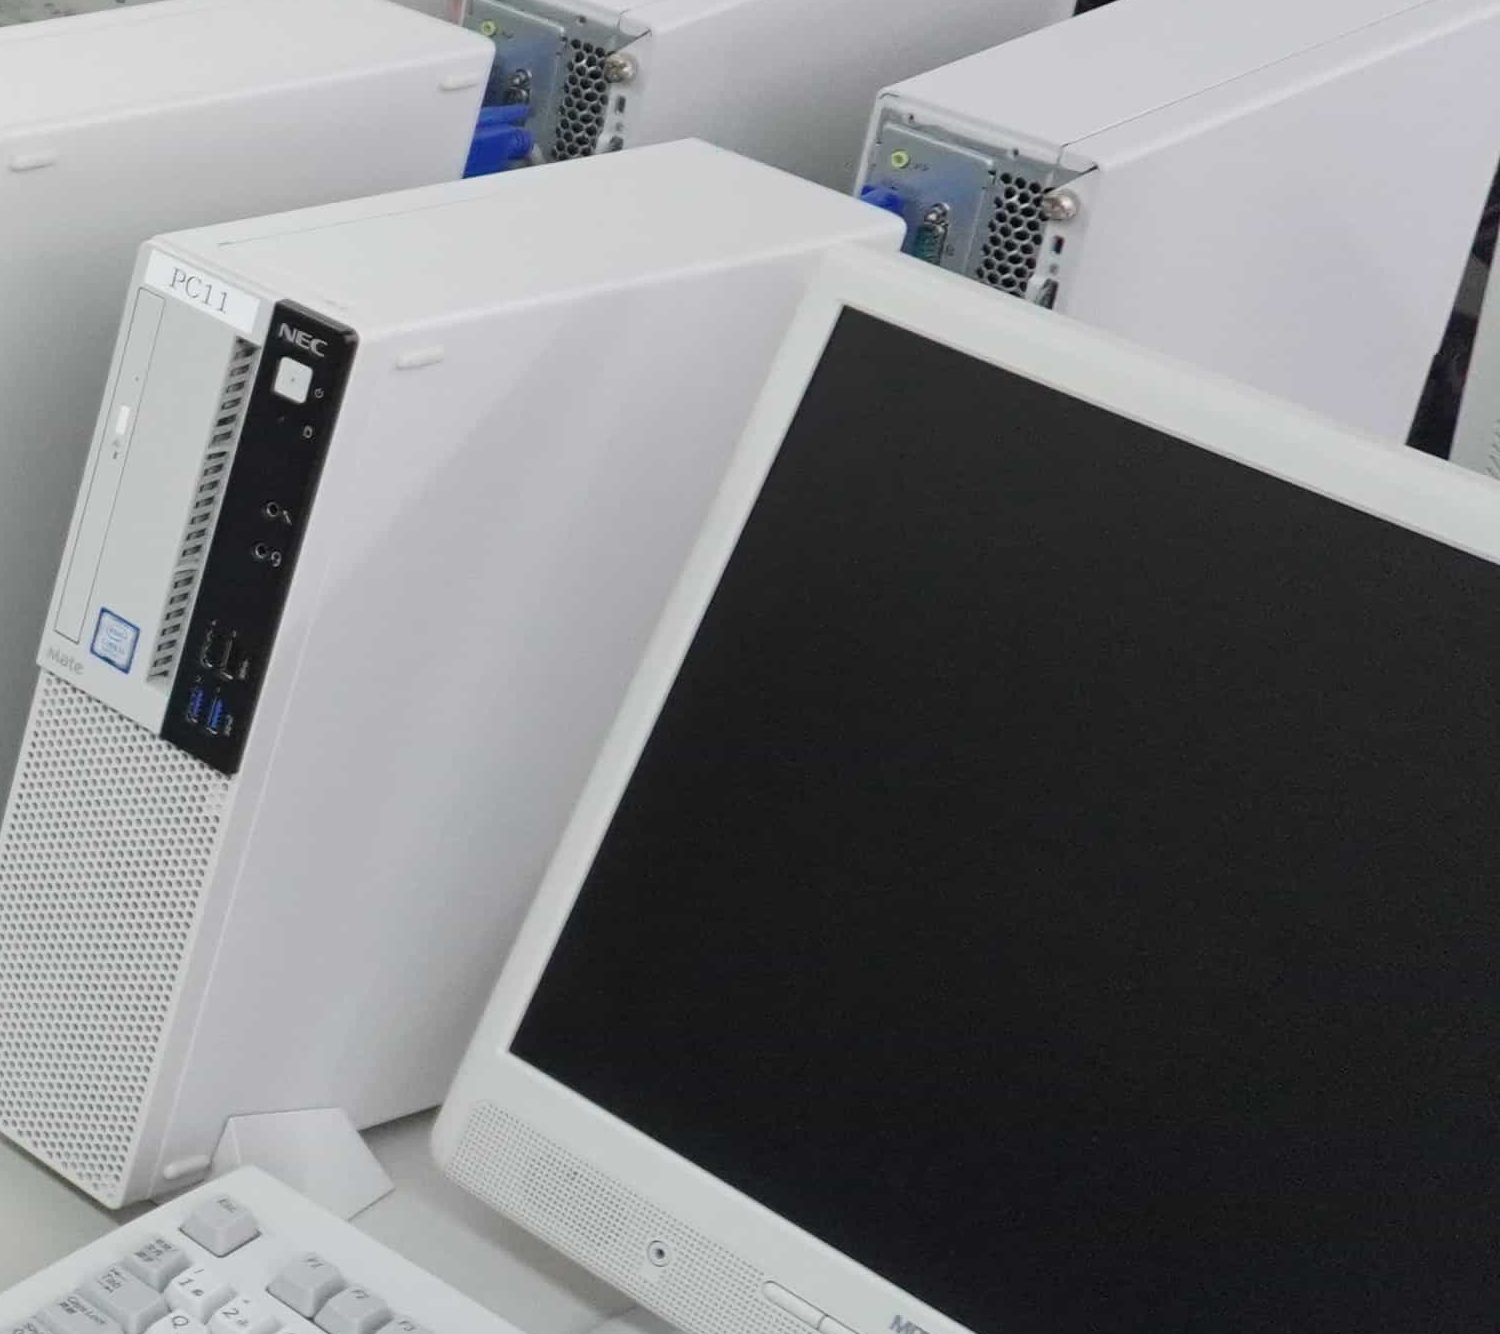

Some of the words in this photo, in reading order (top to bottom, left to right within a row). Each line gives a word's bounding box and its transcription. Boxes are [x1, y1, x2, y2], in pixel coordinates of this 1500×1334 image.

[168, 266, 229, 315] PC11
[278, 322, 329, 357] NEC
[48, 646, 86, 676] Mate
[171, 1314, 189, 1328] Q
[222, 1307, 241, 1318] 2
